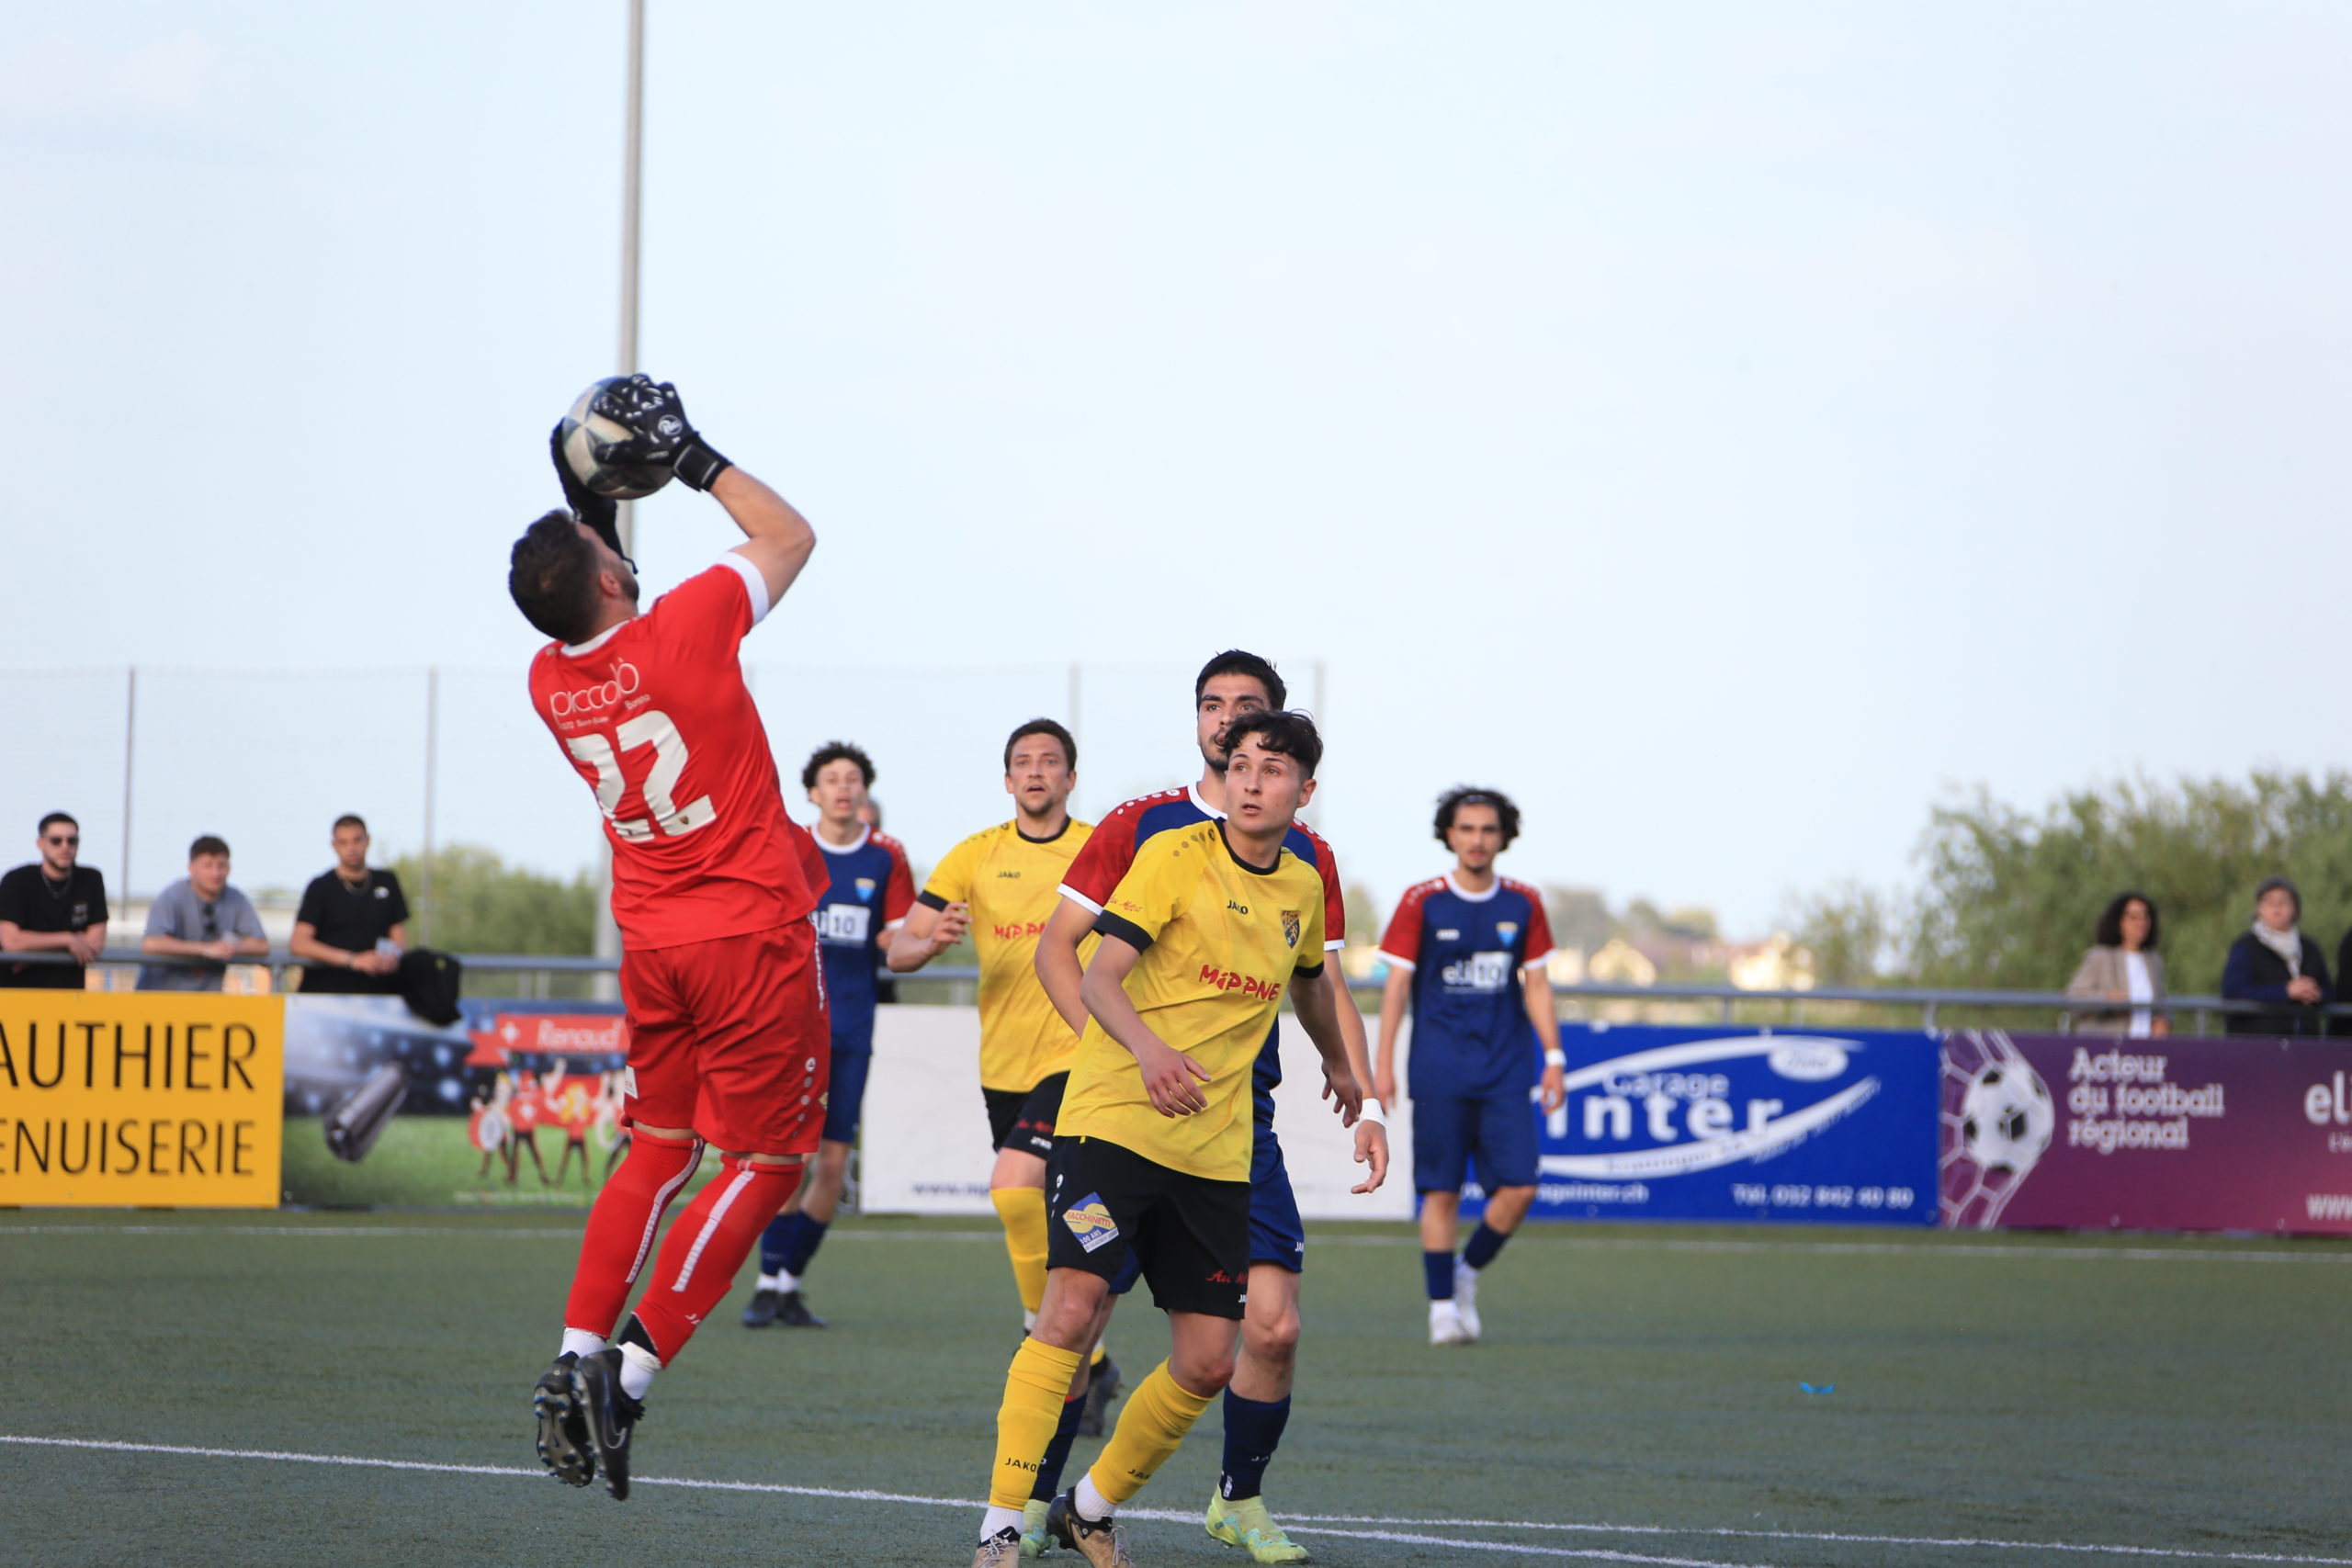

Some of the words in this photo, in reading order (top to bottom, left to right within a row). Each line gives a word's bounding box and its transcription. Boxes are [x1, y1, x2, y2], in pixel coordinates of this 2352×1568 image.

[565, 710, 717, 842] 22
[2069, 1047, 2167, 1082] Acteur
[1603, 1071, 1730, 1101] Garage
[2068, 1082, 2109, 1115] du
[2115, 1083, 2224, 1117] football
[2068, 1114, 2190, 1155] régional
[1770, 1184, 1812, 1207] 032
[1814, 1185, 1854, 1208] 842
[1855, 1186, 1884, 1209] 40
[1884, 1186, 1916, 1210] 80
[1067, 1212, 1111, 1227] FACCHINETTI
[1080, 1235, 1091, 1245] 100
[1090, 1229, 1102, 1239] ANS
[1205, 1269, 1231, 1283] Au
[1005, 1457, 1037, 1472] JAKO
